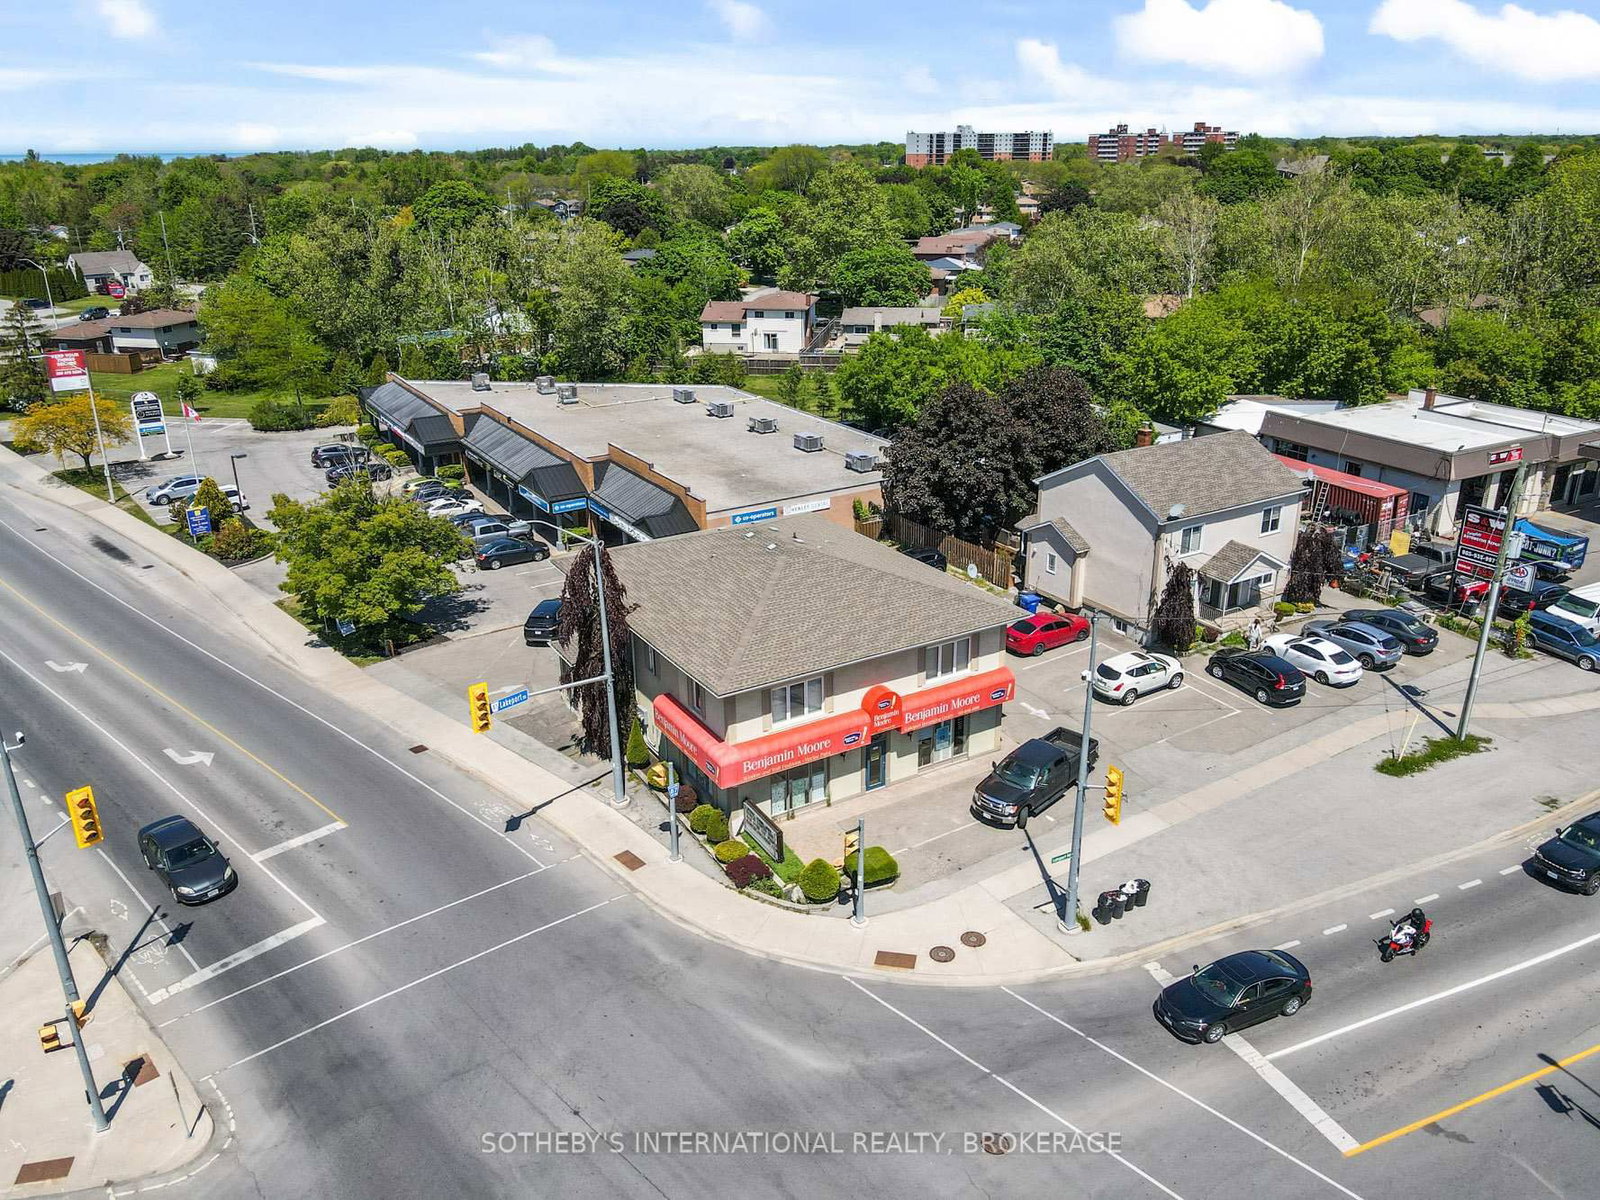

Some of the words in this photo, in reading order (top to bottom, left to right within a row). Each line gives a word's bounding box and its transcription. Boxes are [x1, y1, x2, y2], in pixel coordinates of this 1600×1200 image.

[742, 510, 775, 521] co-operators
[1467, 513, 1480, 524] S
[499, 694, 523, 710] Lakeport
[904, 705, 949, 724] Benjamin
[951, 693, 981, 710] Moore
[873, 710, 900, 722] Benjamin
[873, 718, 891, 728] Moore
[742, 749, 794, 774] Benjamin
[797, 739, 831, 757] Moore
